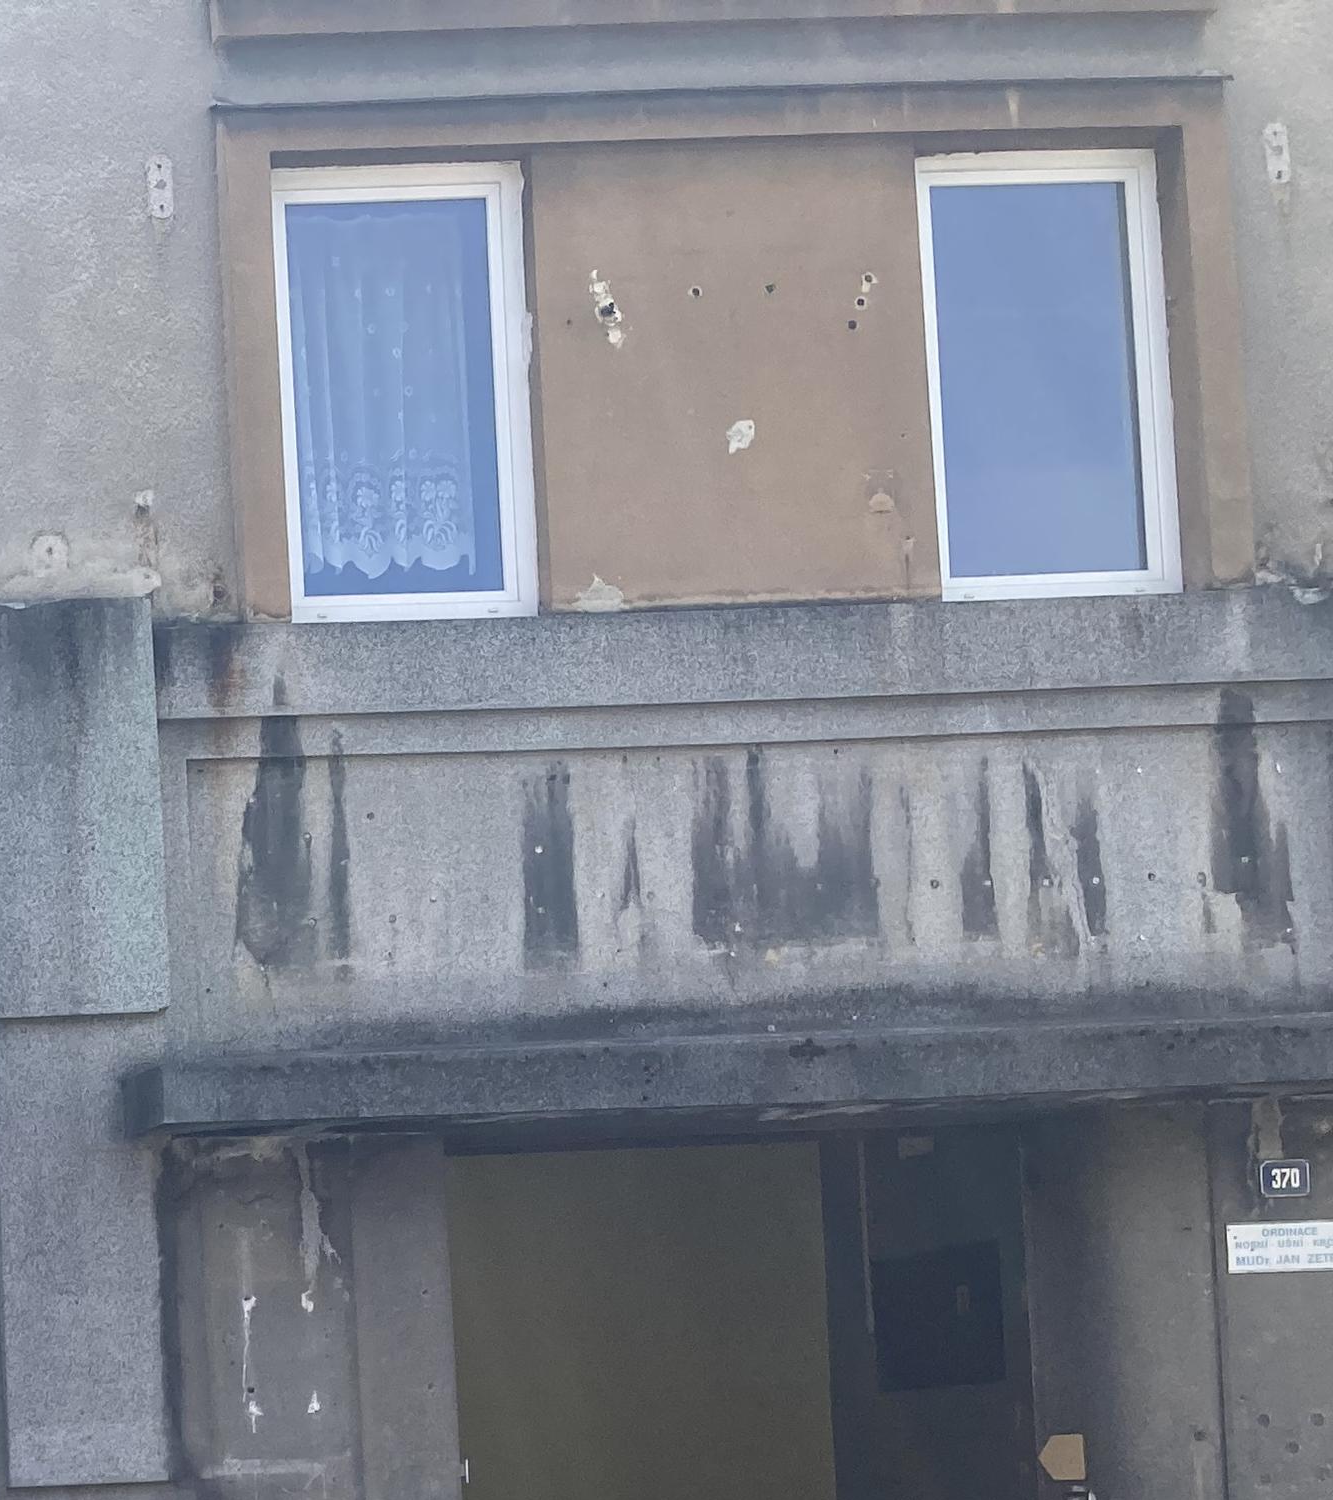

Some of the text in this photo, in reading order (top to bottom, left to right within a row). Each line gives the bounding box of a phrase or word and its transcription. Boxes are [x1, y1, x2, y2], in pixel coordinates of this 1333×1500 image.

[1271, 1168, 1300, 1189] 370
[1262, 1227, 1318, 1237] ORDINACE
[1276, 1254, 1300, 1265] JAN
